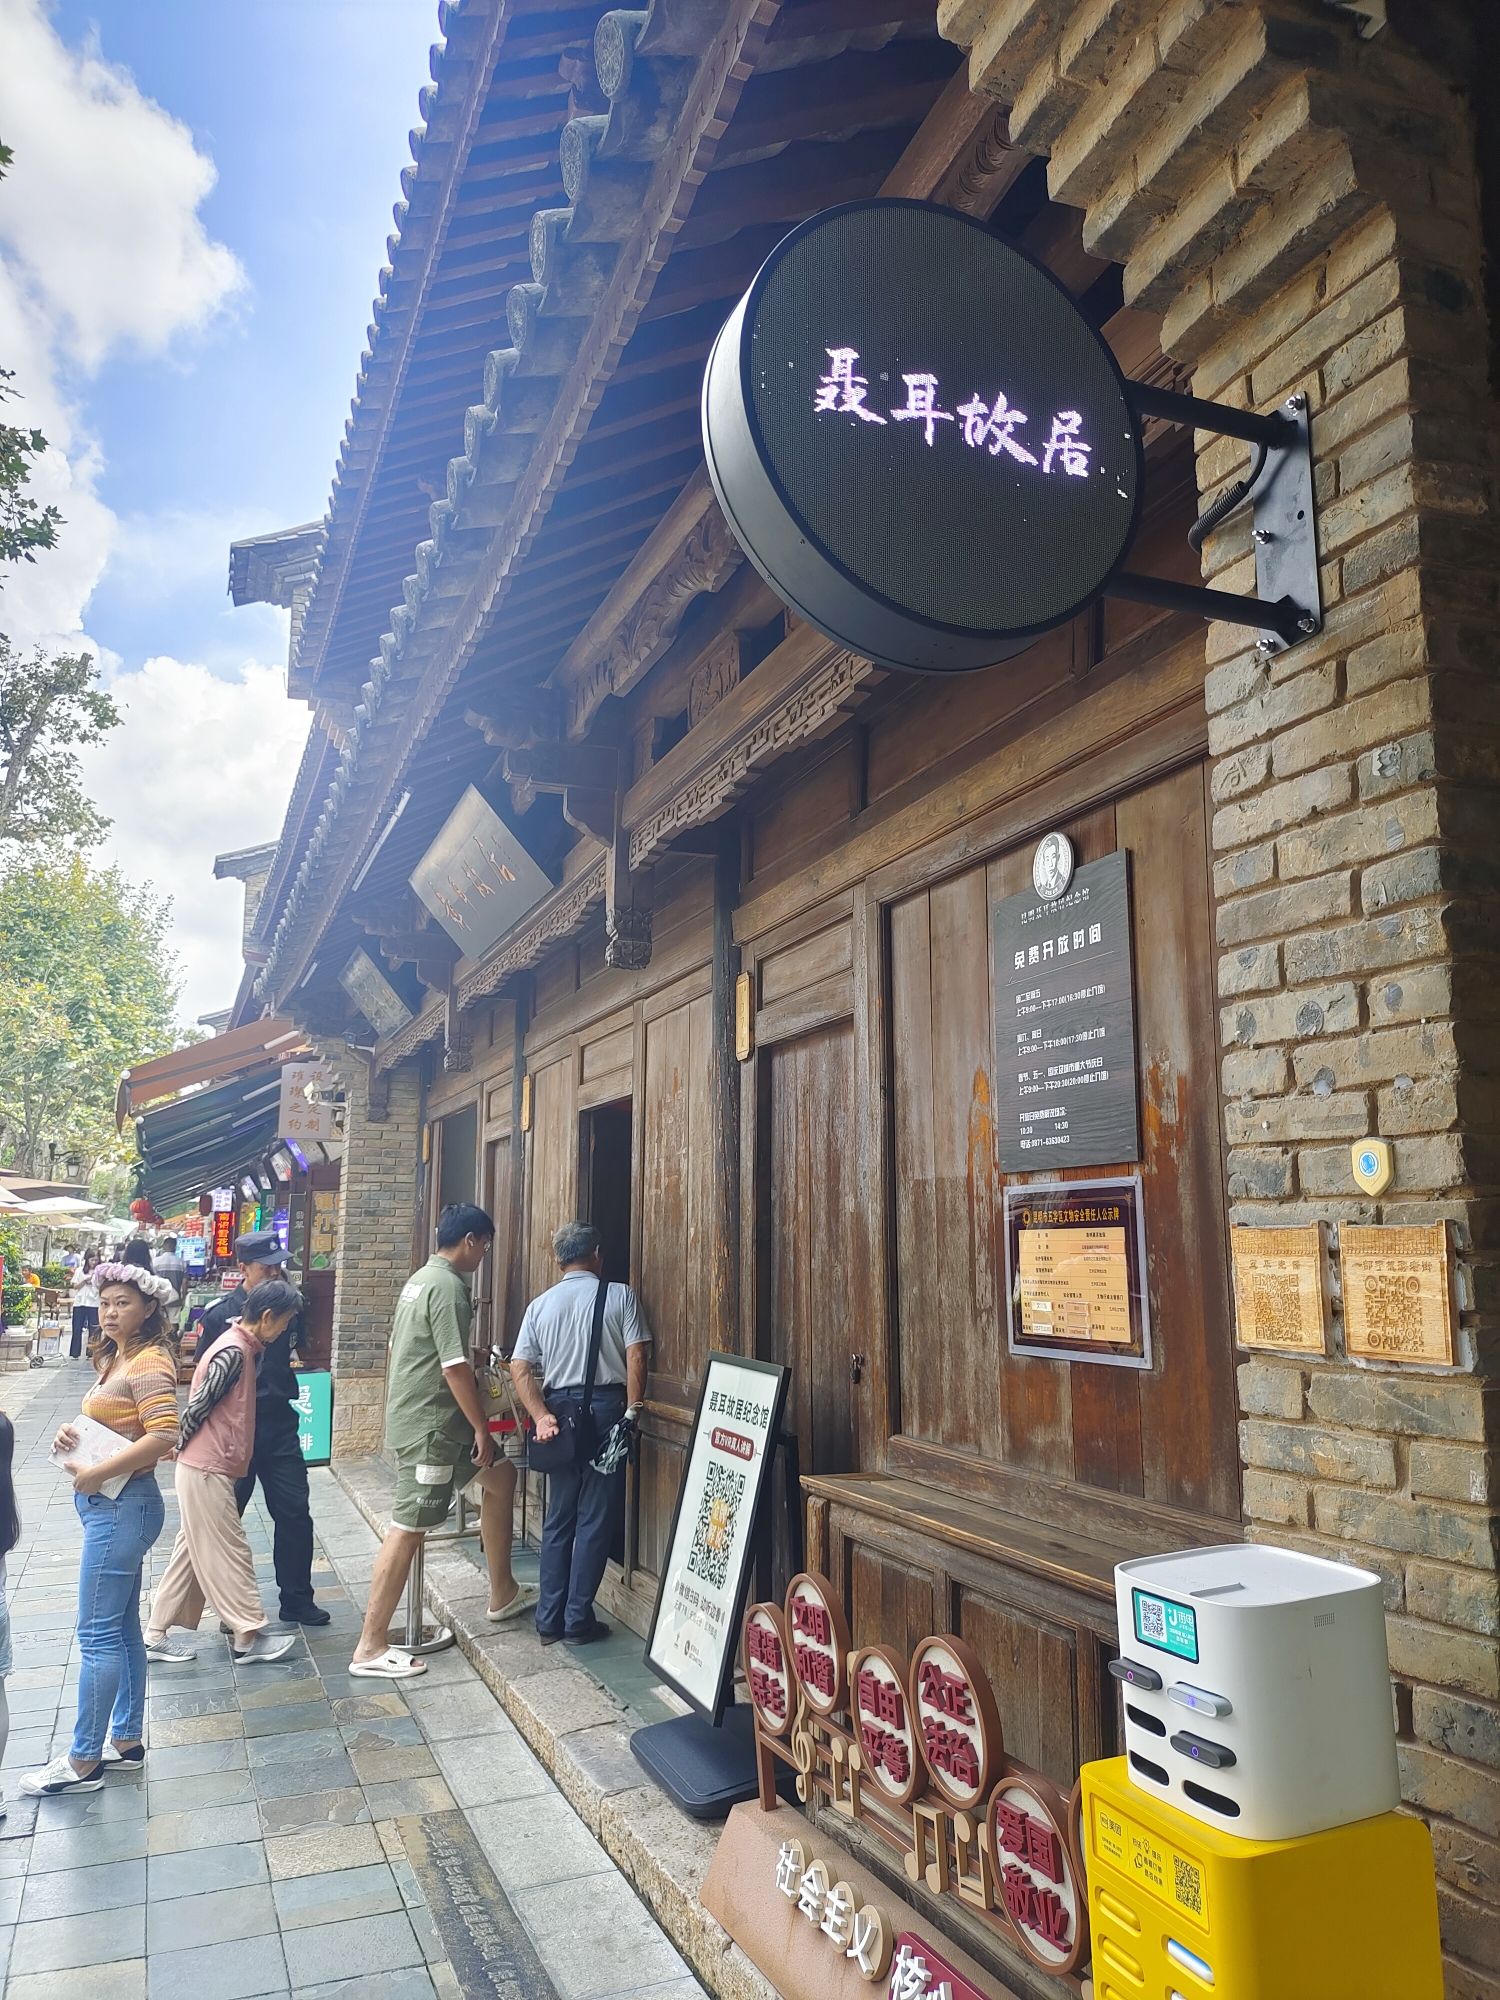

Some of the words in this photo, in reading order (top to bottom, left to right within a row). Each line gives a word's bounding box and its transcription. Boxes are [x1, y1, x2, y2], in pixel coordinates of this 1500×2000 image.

[813, 347, 1093, 478] 聂耳故居
[1014, 923, 1102, 970] 免费开放时间
[1054, 1121, 1069, 1130] 14:30
[708, 1391, 770, 1430] 聂耳故居纪念馆
[746, 1622, 784, 1673] 富强
[789, 1595, 831, 1646] 文明
[749, 1666, 787, 1719] 民主
[793, 1642, 836, 1697] 和谐
[857, 1668, 906, 1731] 自由
[918, 1660, 976, 1727] 公正
[861, 1719, 911, 1784] 平等
[922, 1714, 980, 1789] 法治
[997, 1799, 1066, 1885] 爱国
[776, 1841, 879, 1975] 社会主义
[1001, 1862, 1073, 1954] 敬业
